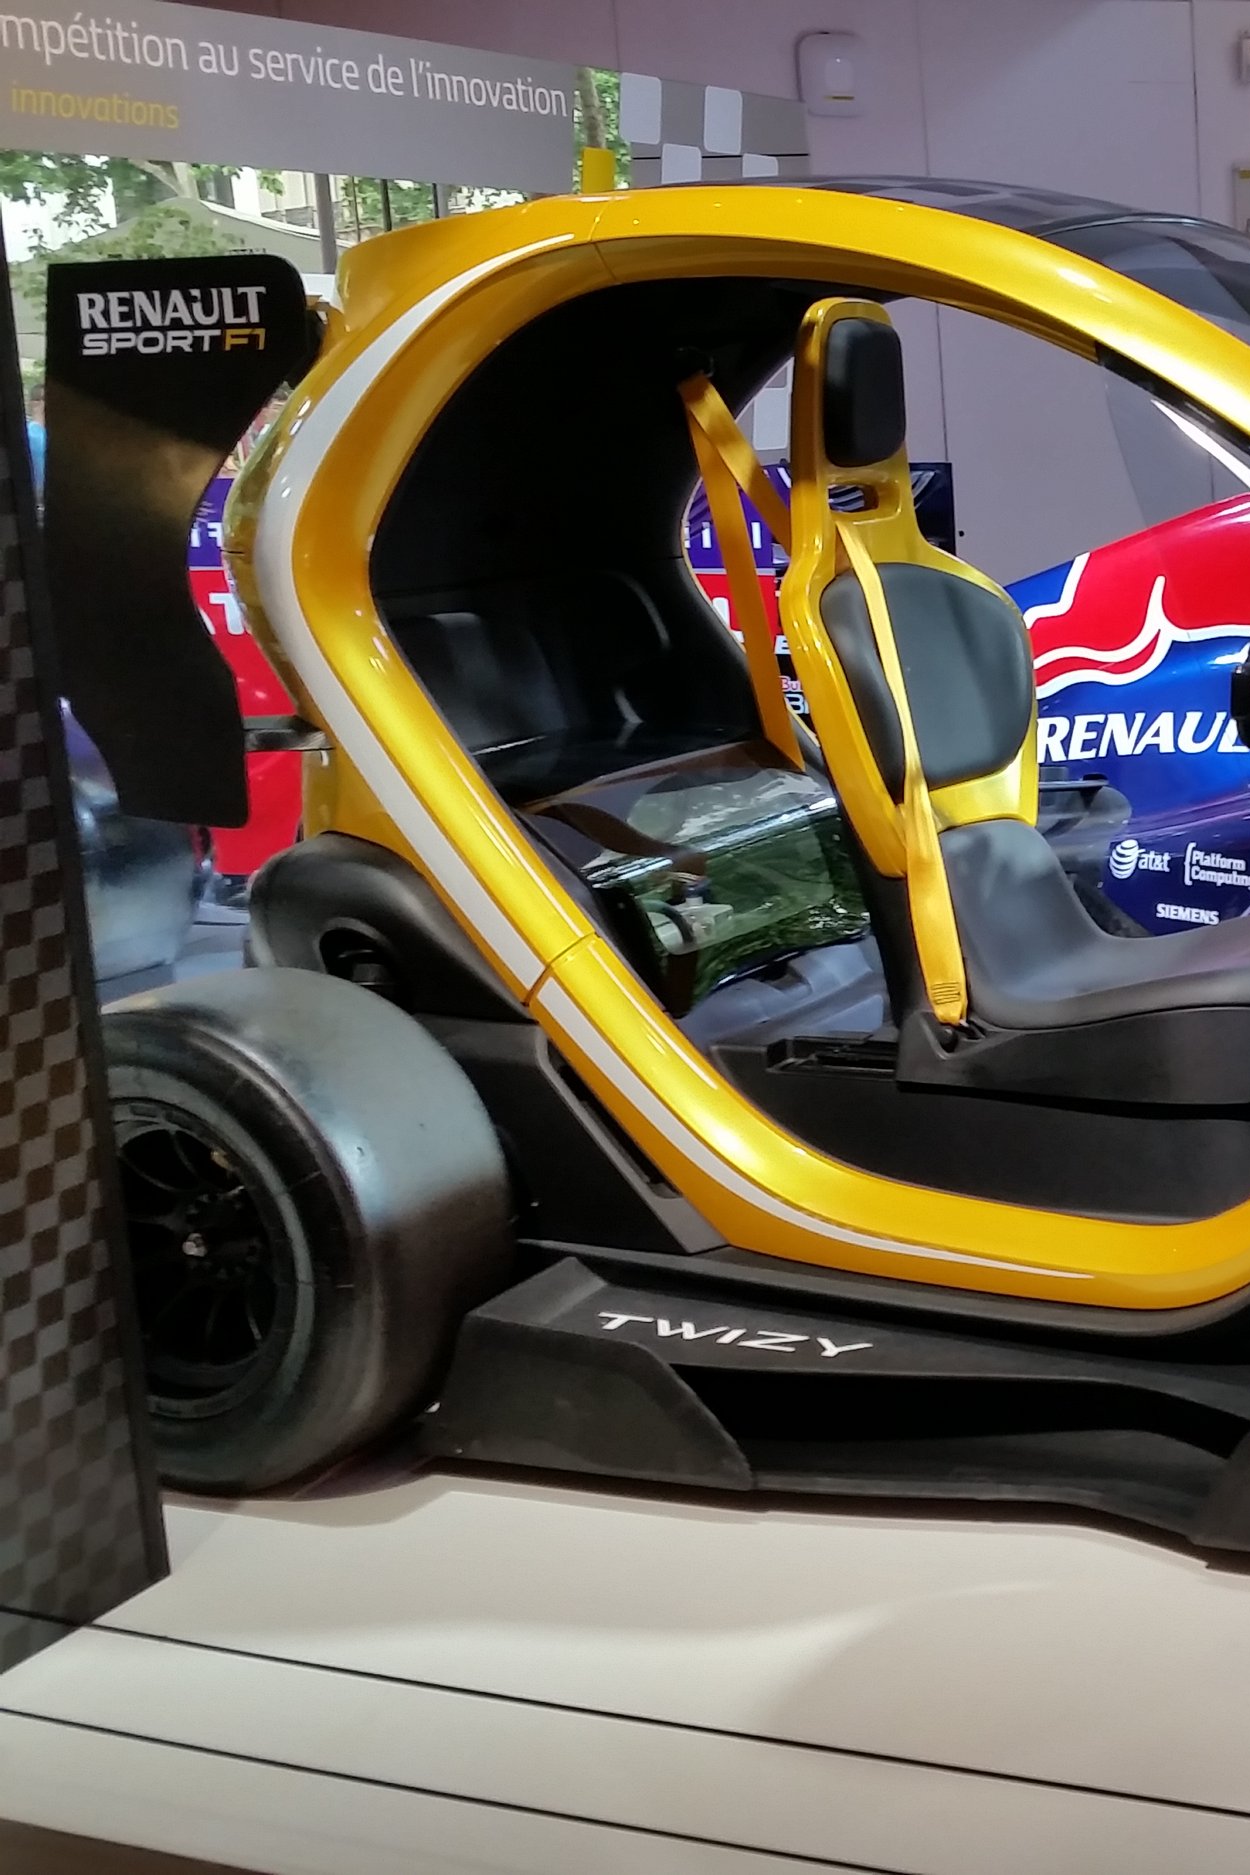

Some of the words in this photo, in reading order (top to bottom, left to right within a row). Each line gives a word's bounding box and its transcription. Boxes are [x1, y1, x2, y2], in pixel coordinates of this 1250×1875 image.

[198, 41, 240, 76] au
[249, 46, 360, 91] service
[367, 54, 405, 96] de
[409, 57, 568, 117] l'innovation
[11, 80, 180, 129] innovations
[77, 286, 267, 329] RENAULT
[1138, 851, 1171, 872] at&t
[1191, 850, 1246, 871] Platform
[1156, 903, 1220, 925] SIEMENS
[598, 1312, 873, 1357] TWIZY
